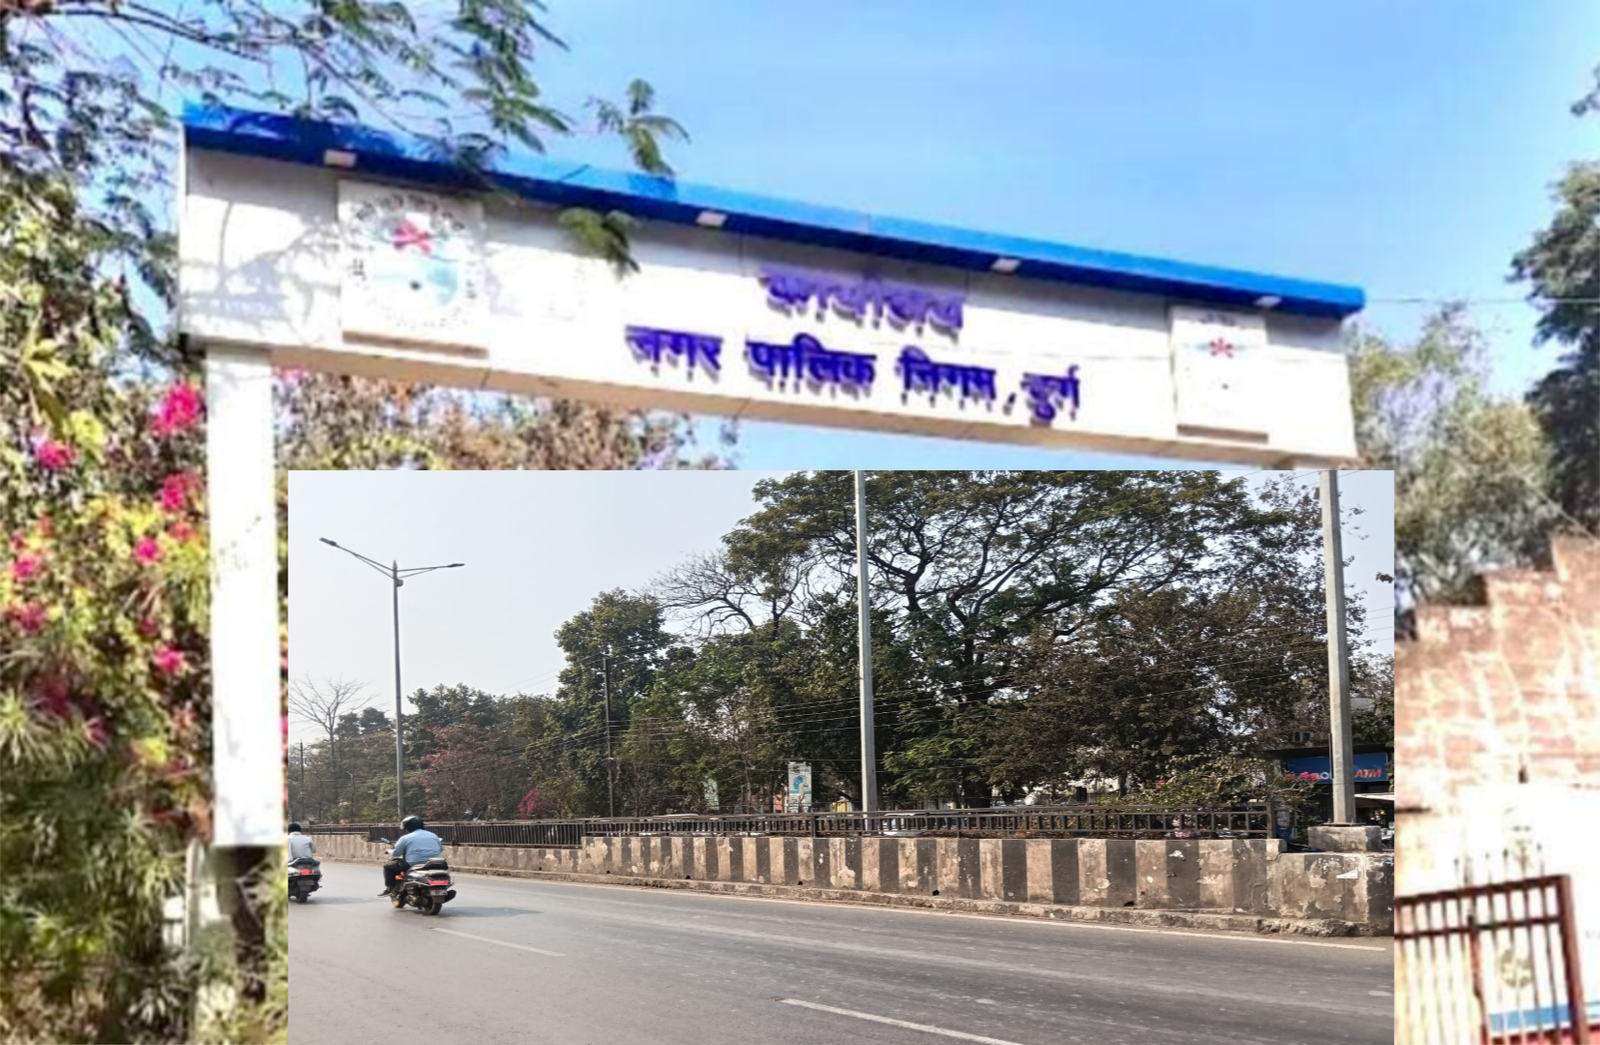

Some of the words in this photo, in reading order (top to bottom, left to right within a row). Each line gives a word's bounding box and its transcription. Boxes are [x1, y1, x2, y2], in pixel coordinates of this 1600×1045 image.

[625, 325, 724, 371] नगर
[744, 333, 878, 386] पालिक
[1354, 769, 1382, 779] ATM
